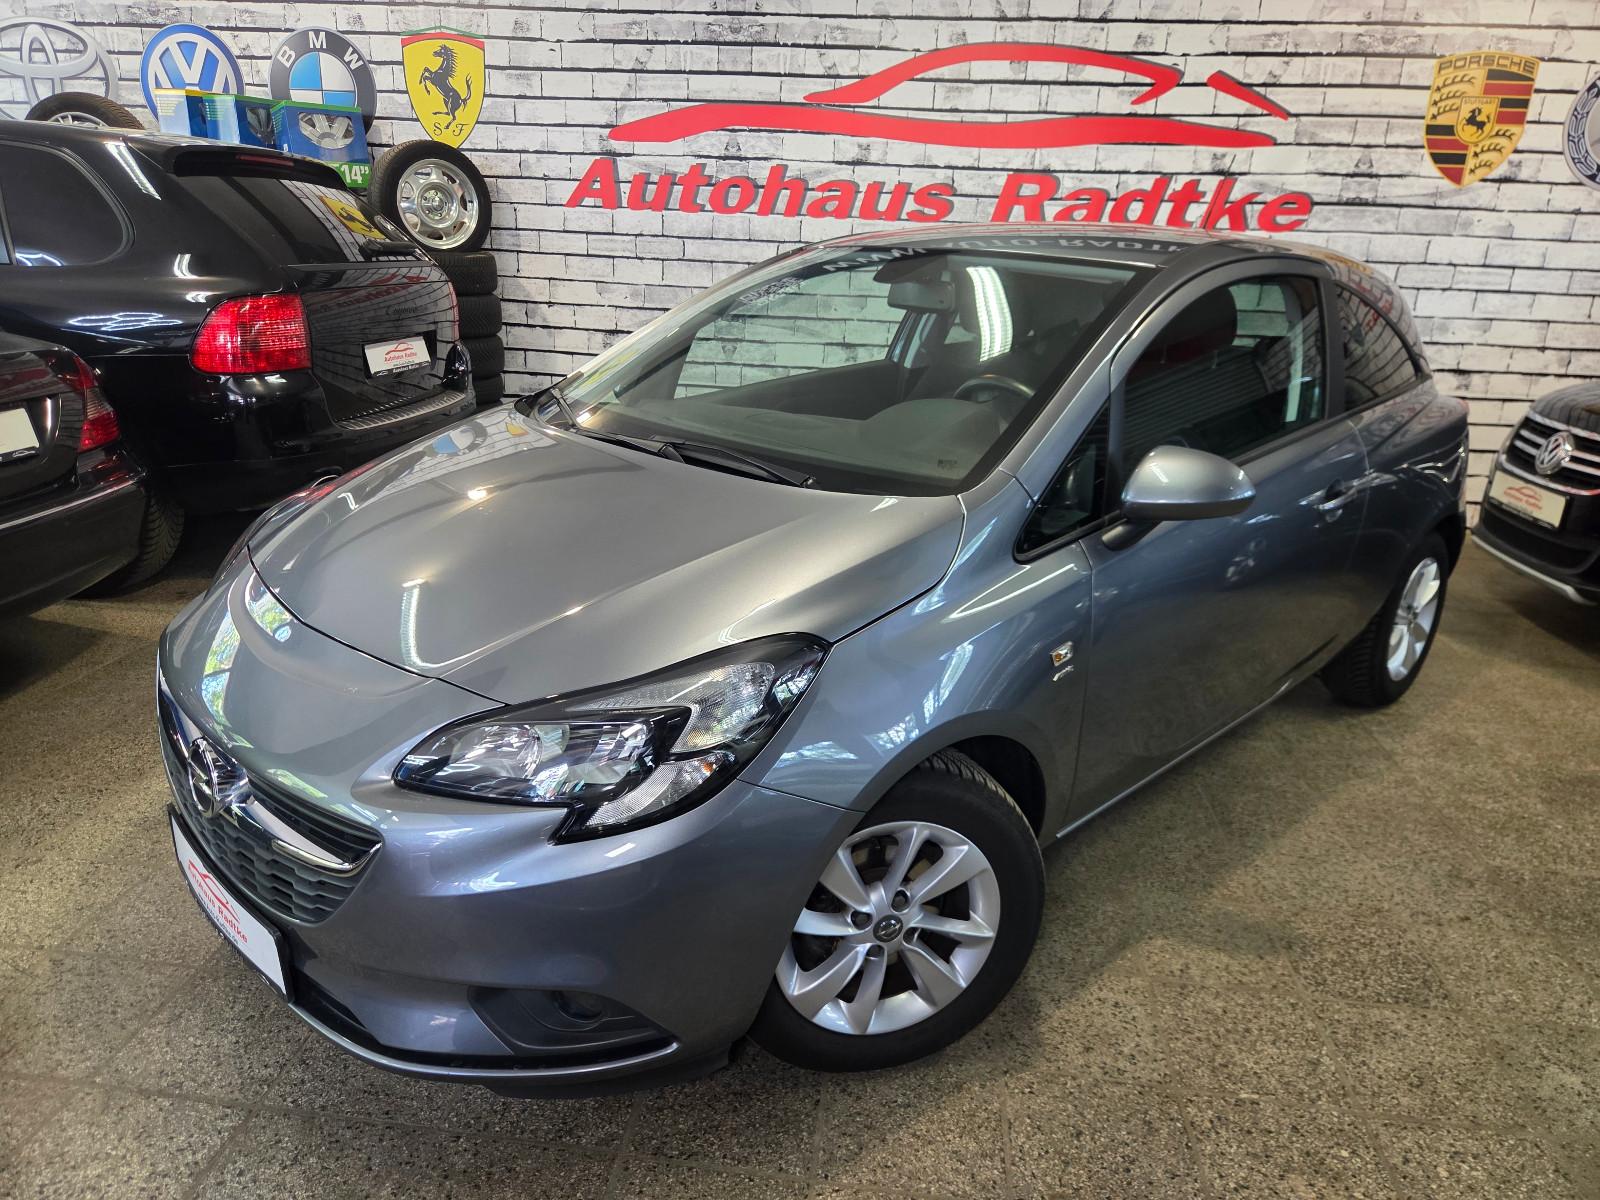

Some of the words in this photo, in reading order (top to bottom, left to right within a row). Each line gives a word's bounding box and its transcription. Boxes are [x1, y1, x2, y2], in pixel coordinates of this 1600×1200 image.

[1438, 54, 1536, 74] PORSCHE
[433, 122, 444, 137] S
[566, 157, 956, 222] Autohaus
[991, 174, 1314, 232] Radtke
[218, 904, 248, 944] Radtke
